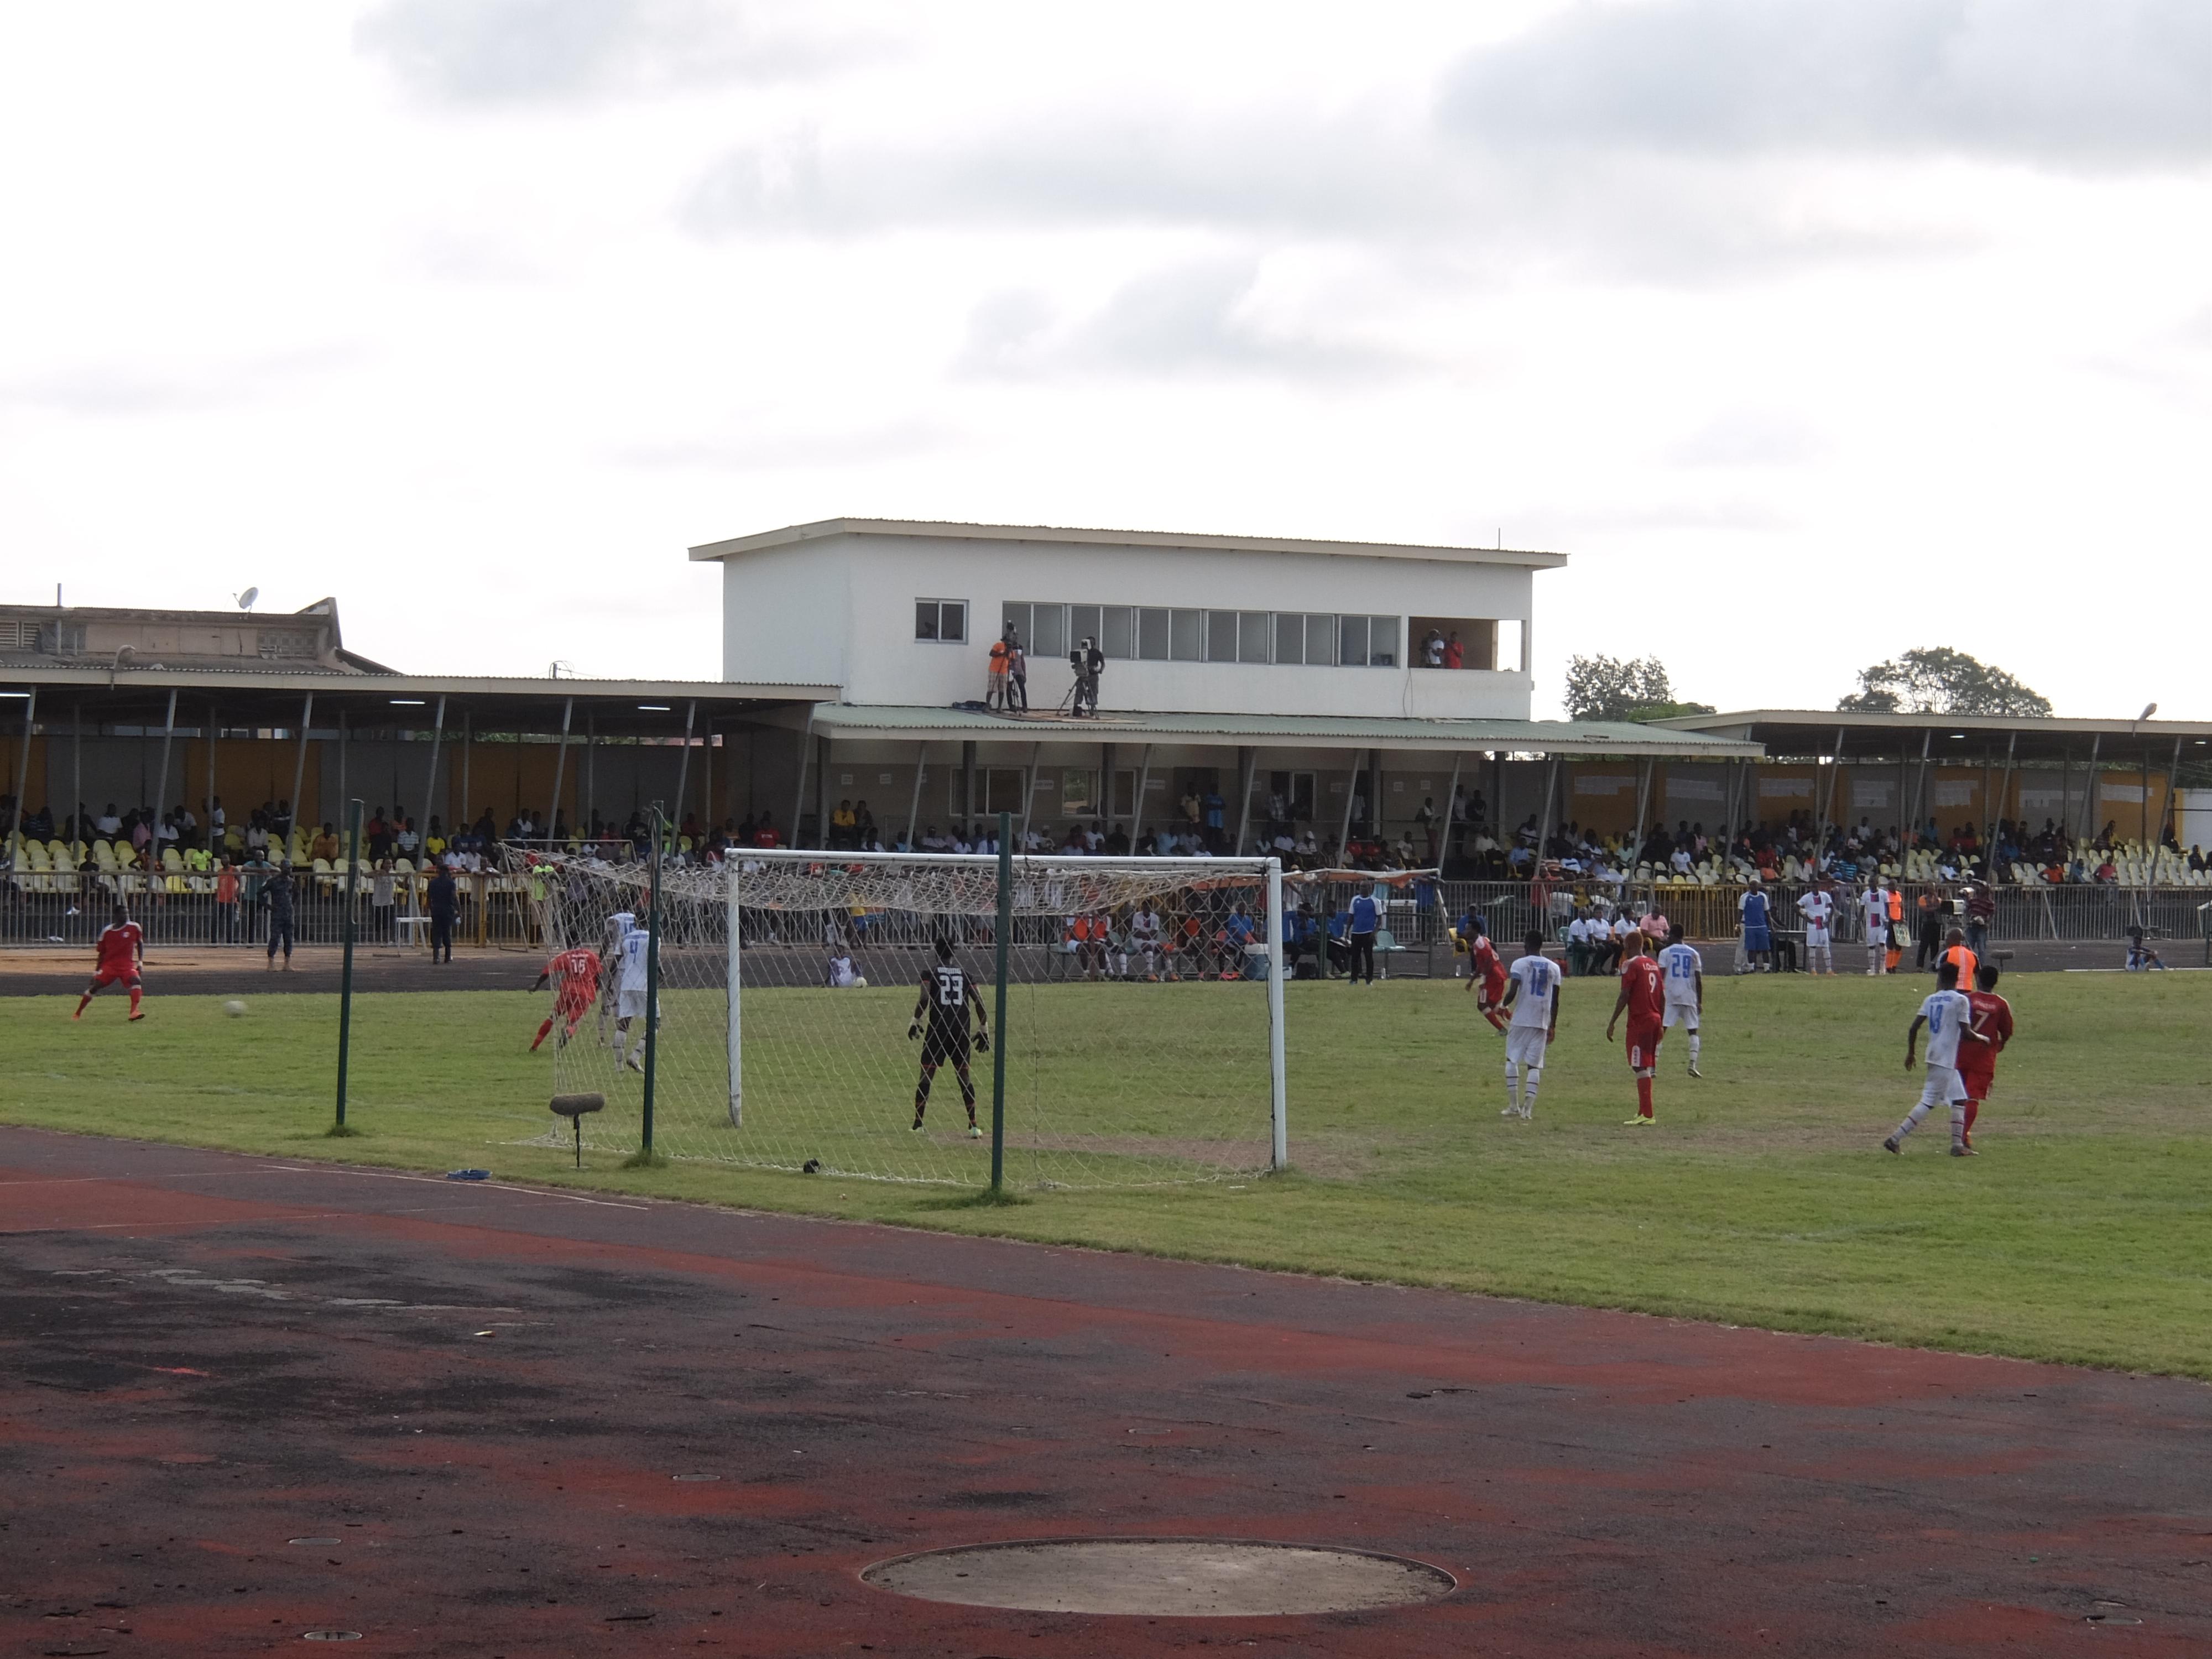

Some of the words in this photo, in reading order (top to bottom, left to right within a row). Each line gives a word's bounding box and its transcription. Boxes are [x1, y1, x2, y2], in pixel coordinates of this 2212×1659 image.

[1672, 954, 1692, 978] 29
[940, 975, 963, 1005] 23
[1531, 968, 1548, 997] 12
[1648, 972, 1657, 993] 9
[1974, 1010, 1990, 1031] 7
